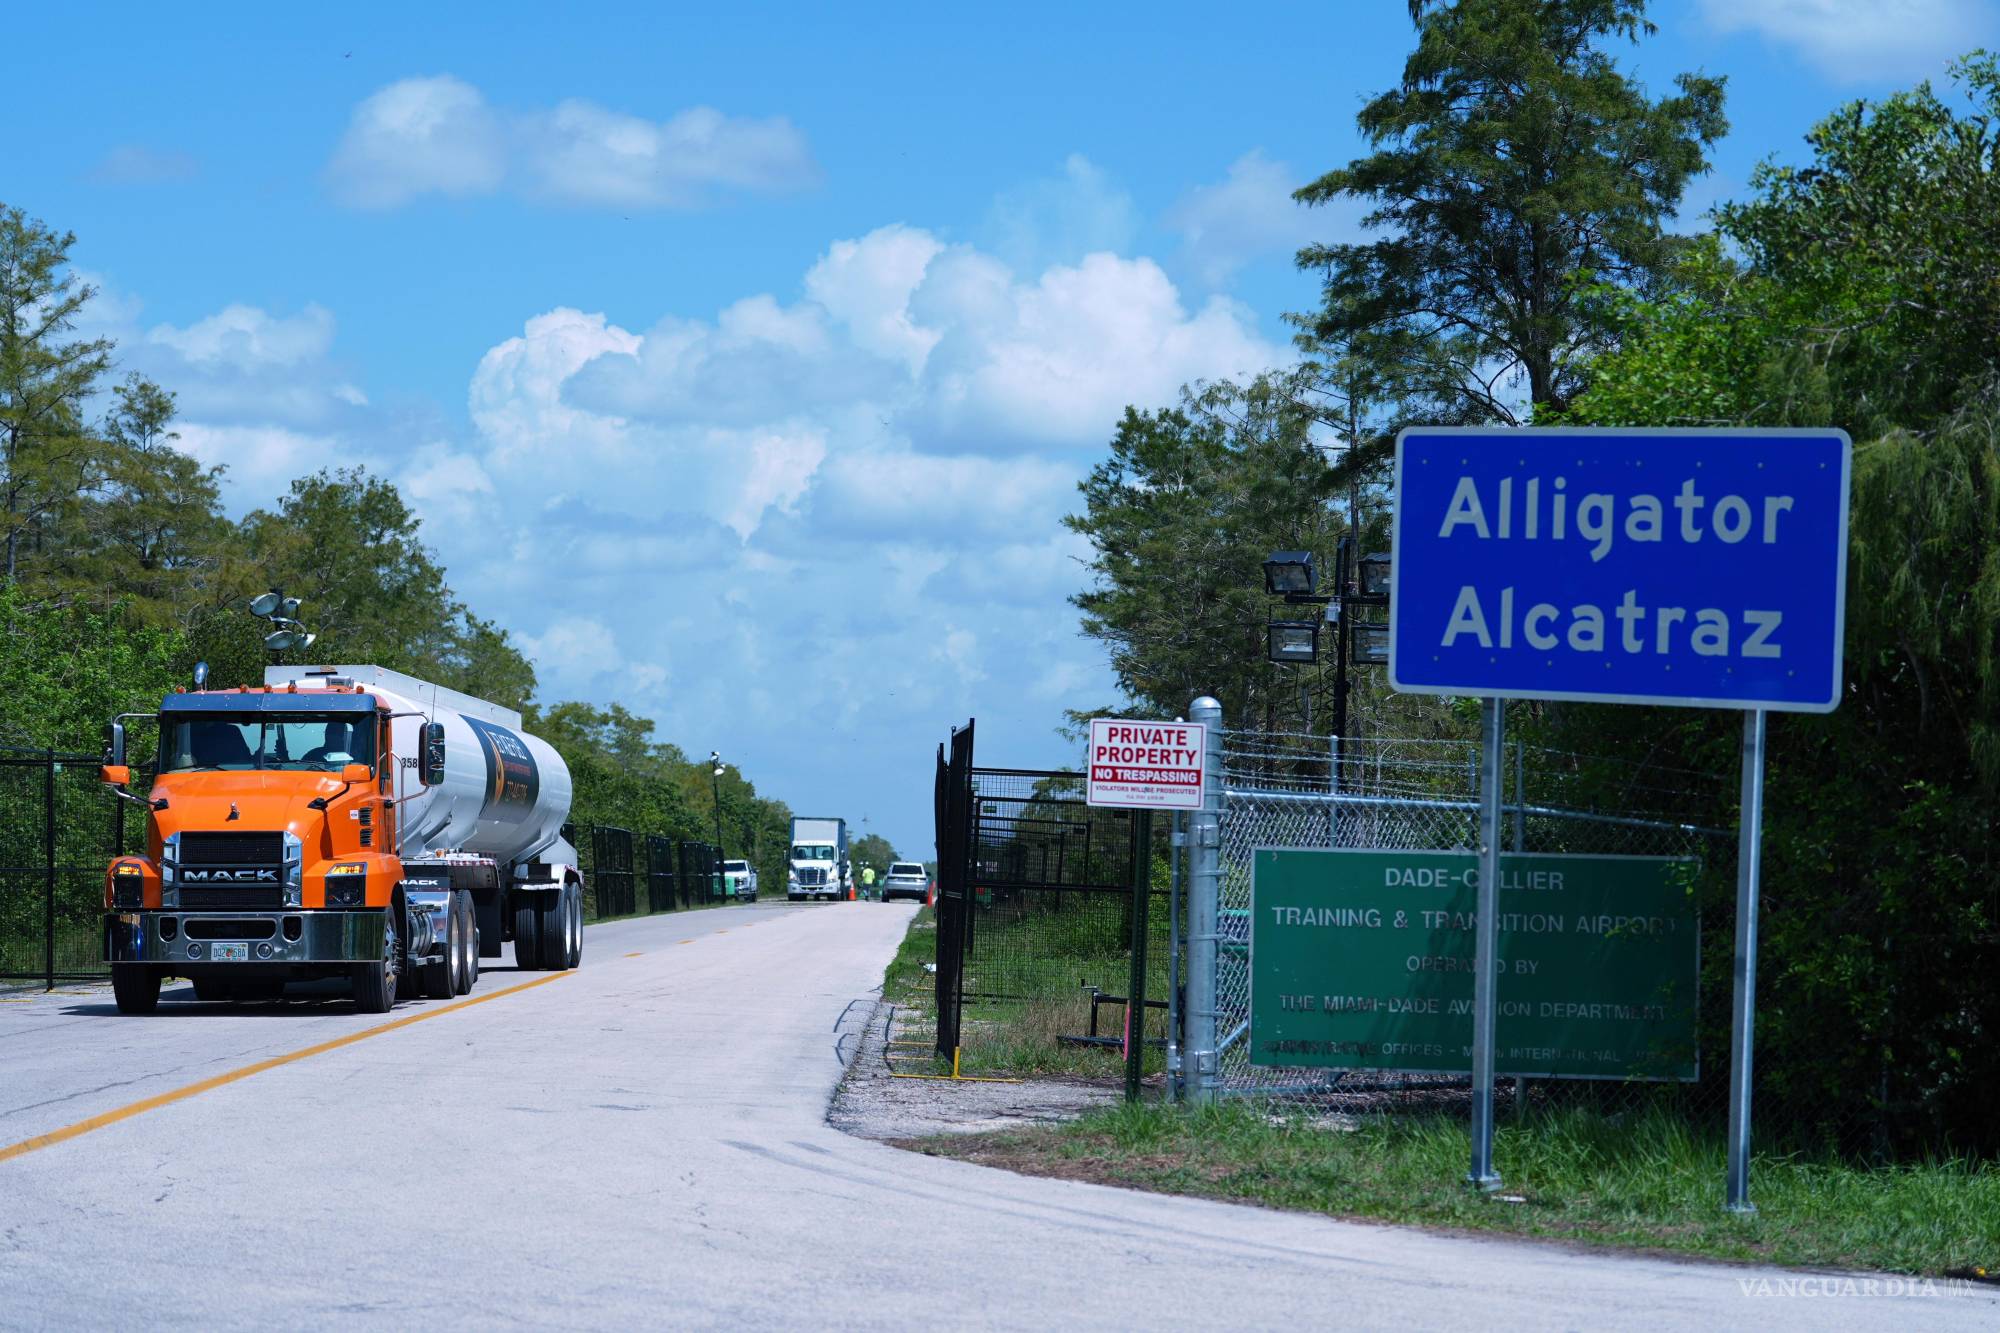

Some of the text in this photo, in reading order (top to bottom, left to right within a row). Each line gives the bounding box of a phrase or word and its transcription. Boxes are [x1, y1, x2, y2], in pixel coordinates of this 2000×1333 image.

[1438, 476, 1794, 562] Alligator
[1440, 585, 1783, 659] Alcatraz
[1108, 727, 1187, 746] PRIVATE
[1096, 745, 1197, 766] PROPERTY
[1095, 768, 1198, 784] NO TRESPASSING
[1156, 787, 1197, 795] PROSECUTED
[184, 870, 278, 881] MACK
[1385, 868, 1564, 890] DADE-CLLIER
[1272, 906, 1381, 929] TRAINING
[1393, 909, 1409, 929] &
[1420, 911, 1564, 933] TRANITION
[1515, 959, 1540, 975] BY
[1279, 994, 1315, 1011] THE
[1323, 995, 1440, 1014] MIAMI-DADE
[1382, 1042, 1442, 1057] OFFICES
